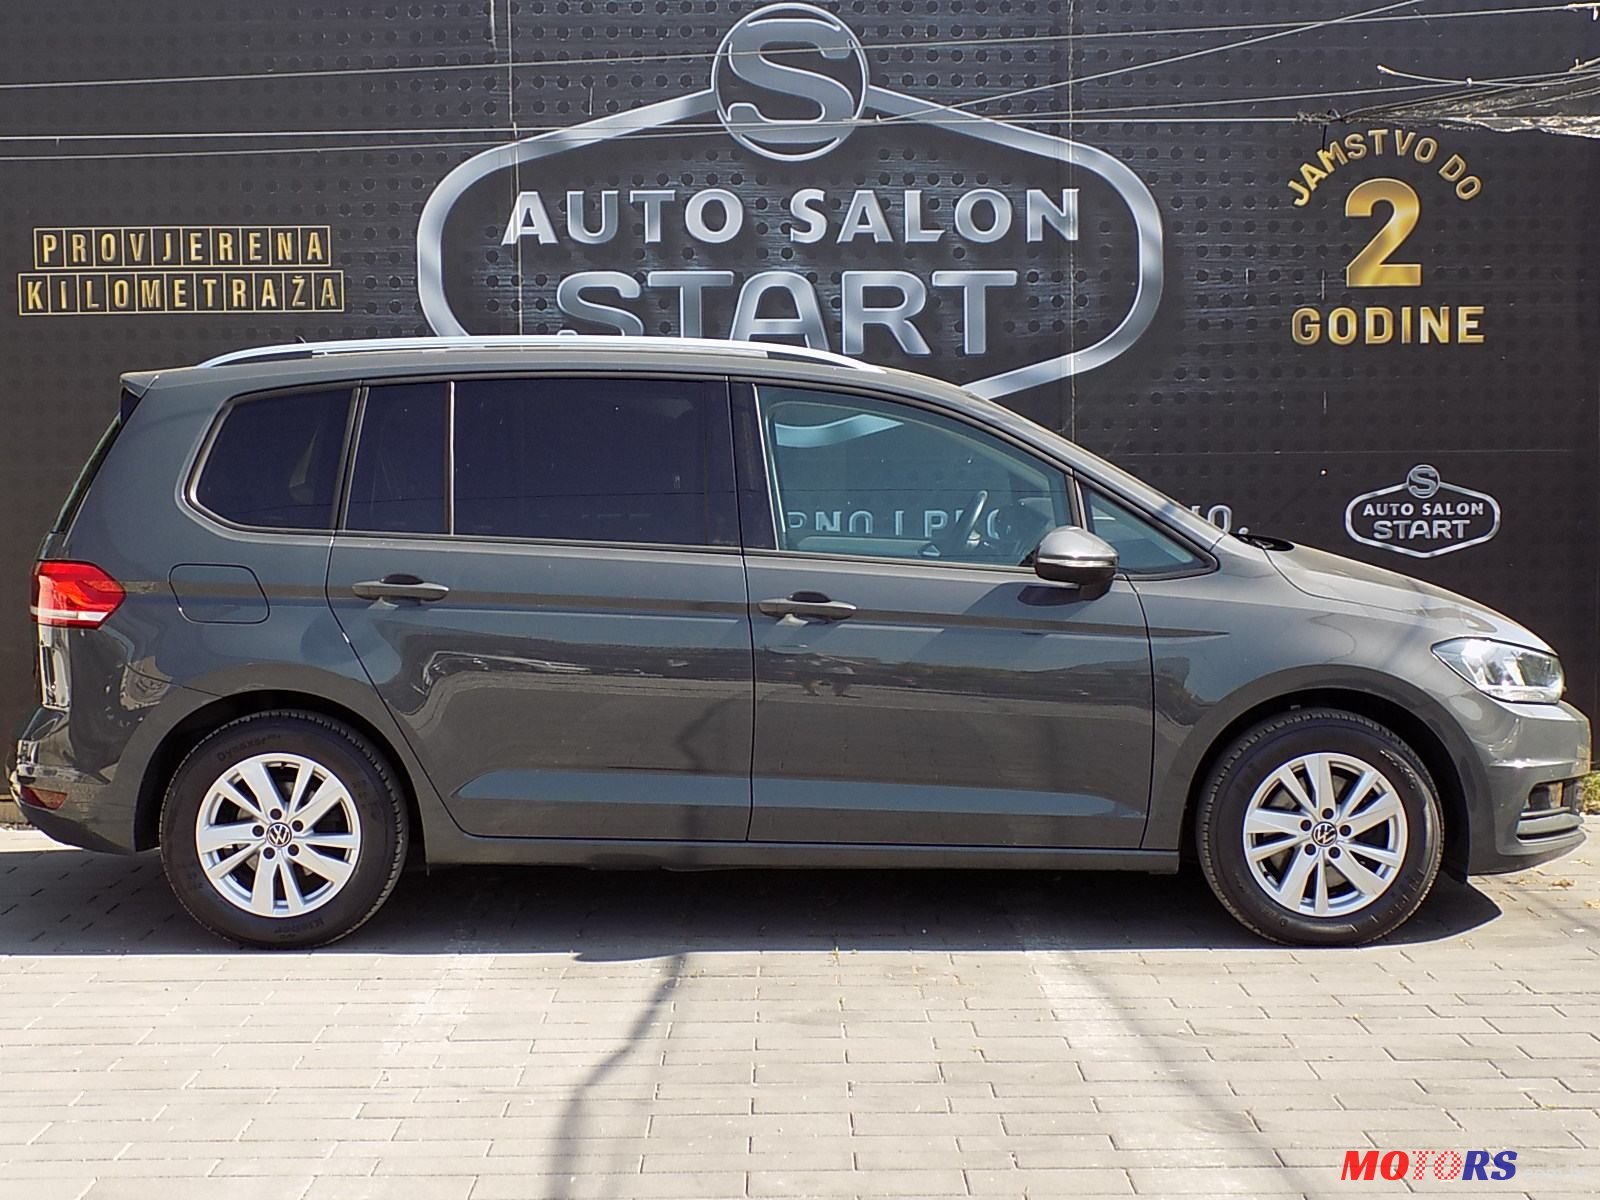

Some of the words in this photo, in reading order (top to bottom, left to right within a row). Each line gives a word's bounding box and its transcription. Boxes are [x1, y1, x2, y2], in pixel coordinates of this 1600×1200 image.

[1288, 128, 1438, 207] JAMSTVO
[1438, 153, 1482, 201] DO
[502, 188, 744, 245] AUTO
[790, 188, 1080, 244] SALON
[1345, 177, 1421, 288] 2
[42, 231, 323, 263] PROVJERENA
[27, 274, 337, 310] KILOMETRAŽA
[556, 270, 1018, 356] START
[1291, 306, 1485, 345] GODINE
[1363, 503, 1414, 516] AUTO
[1422, 502, 1484, 516] SALON
[1373, 519, 1470, 539] START
